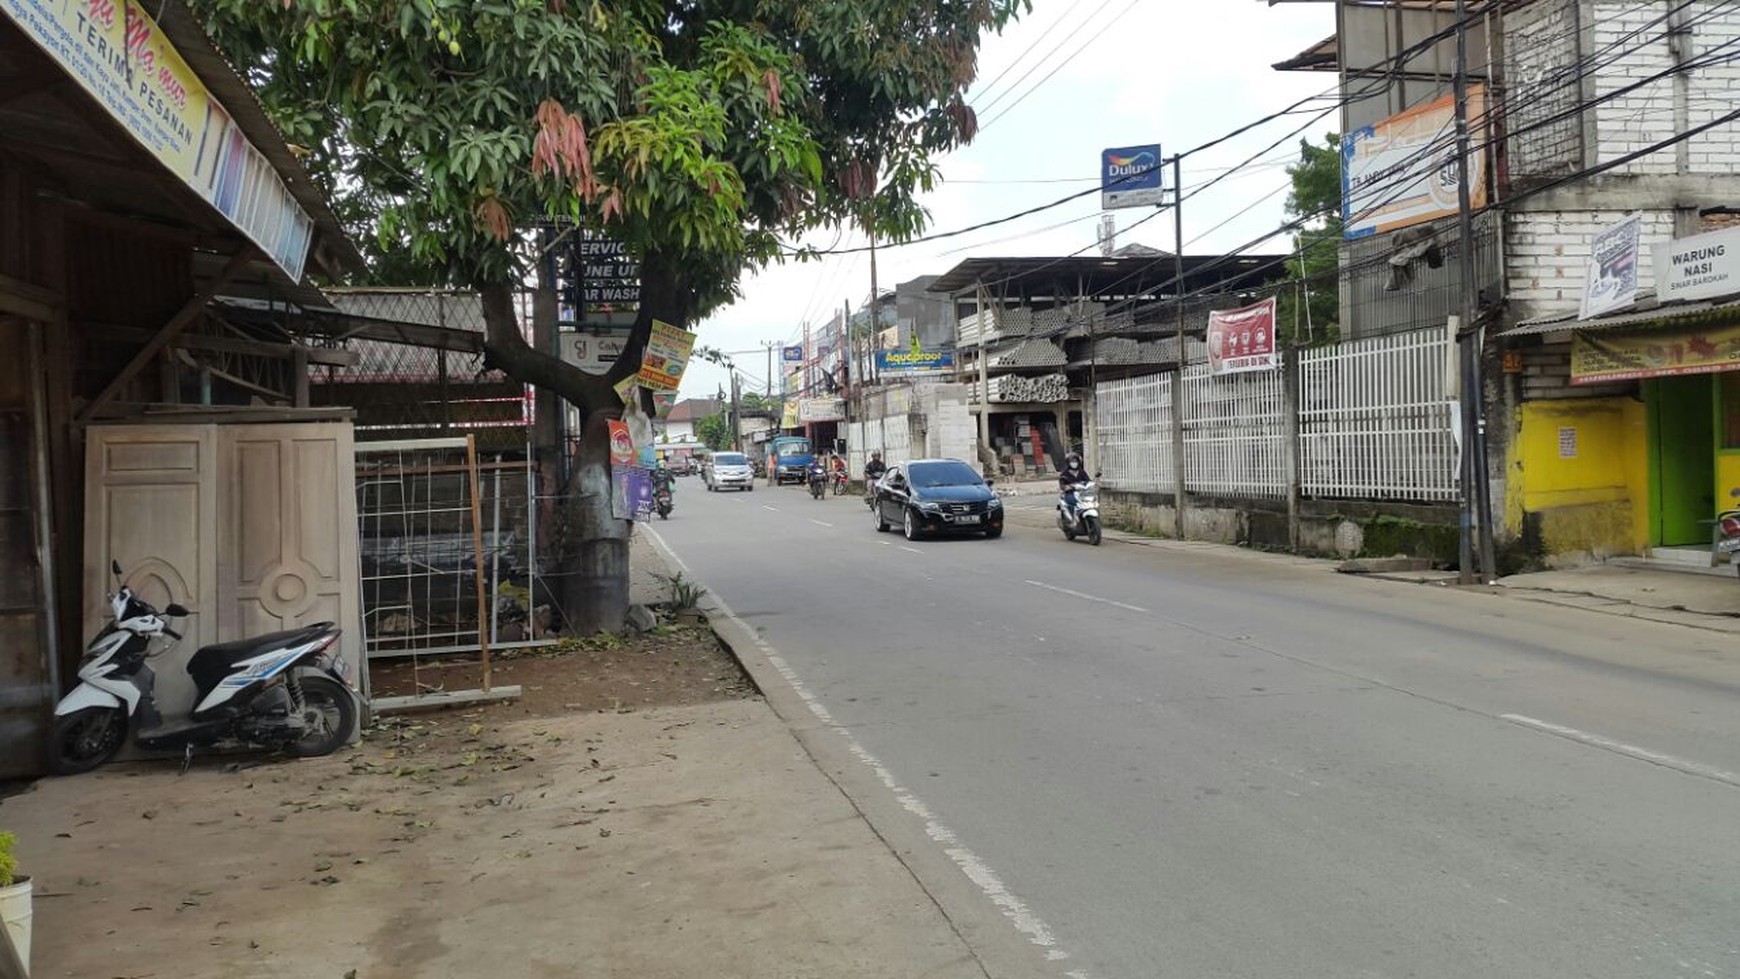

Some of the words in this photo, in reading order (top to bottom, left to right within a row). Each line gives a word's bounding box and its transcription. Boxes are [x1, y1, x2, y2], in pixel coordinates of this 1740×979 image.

[139, 81, 193, 145] PESANAN
[1108, 162, 1154, 177] Dulux
[1672, 245, 1725, 265] WARUNG
[1684, 262, 1712, 277] NASI
[602, 288, 640, 300] WASH
